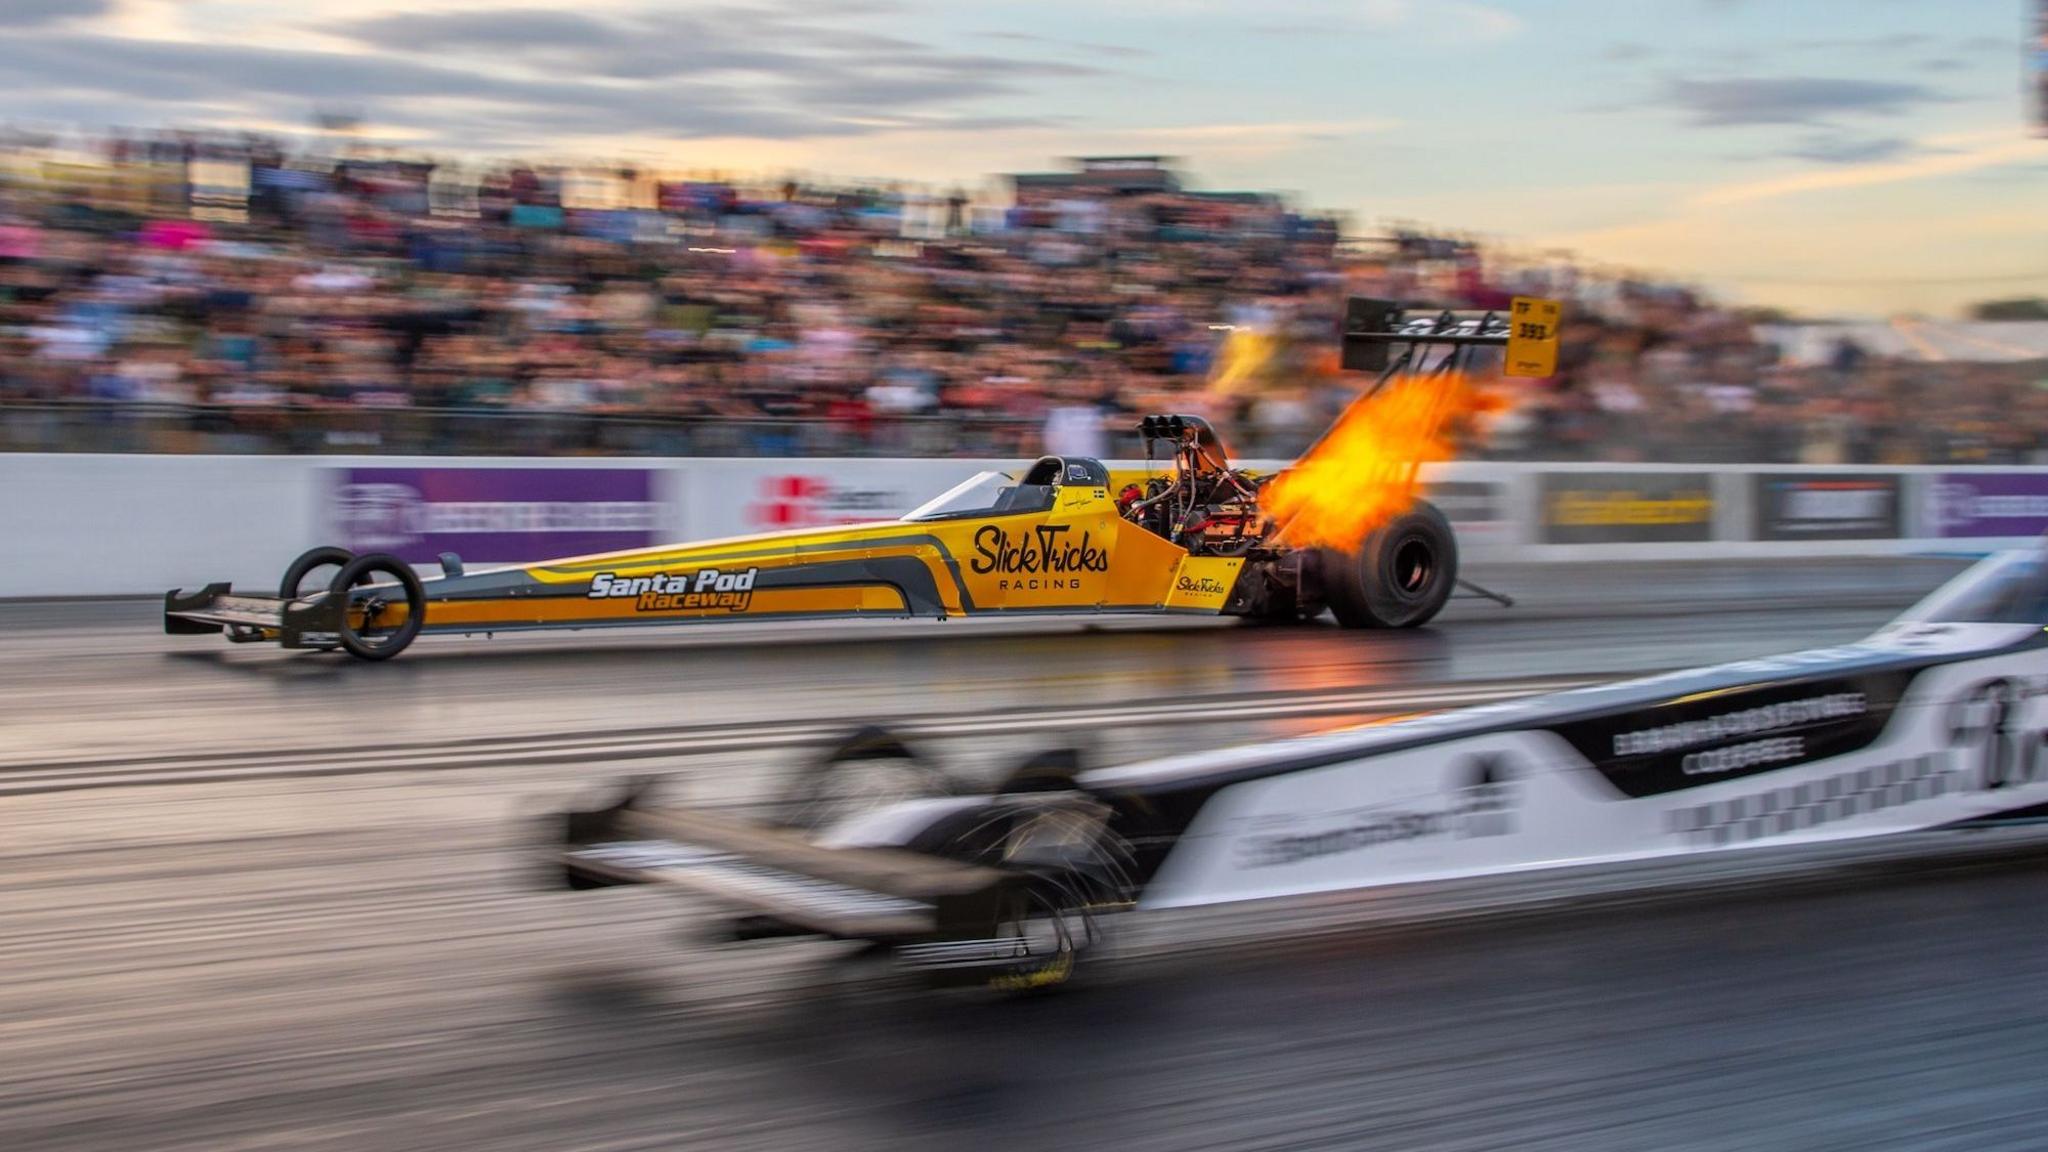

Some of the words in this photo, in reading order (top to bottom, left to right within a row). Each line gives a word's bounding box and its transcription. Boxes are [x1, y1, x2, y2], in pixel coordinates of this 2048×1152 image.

[1518, 322, 1547, 340] 393
[587, 572, 689, 598] Santa
[693, 567, 758, 593] Pod
[999, 578, 1080, 590] RACING
[637, 590, 750, 611] Raceway
